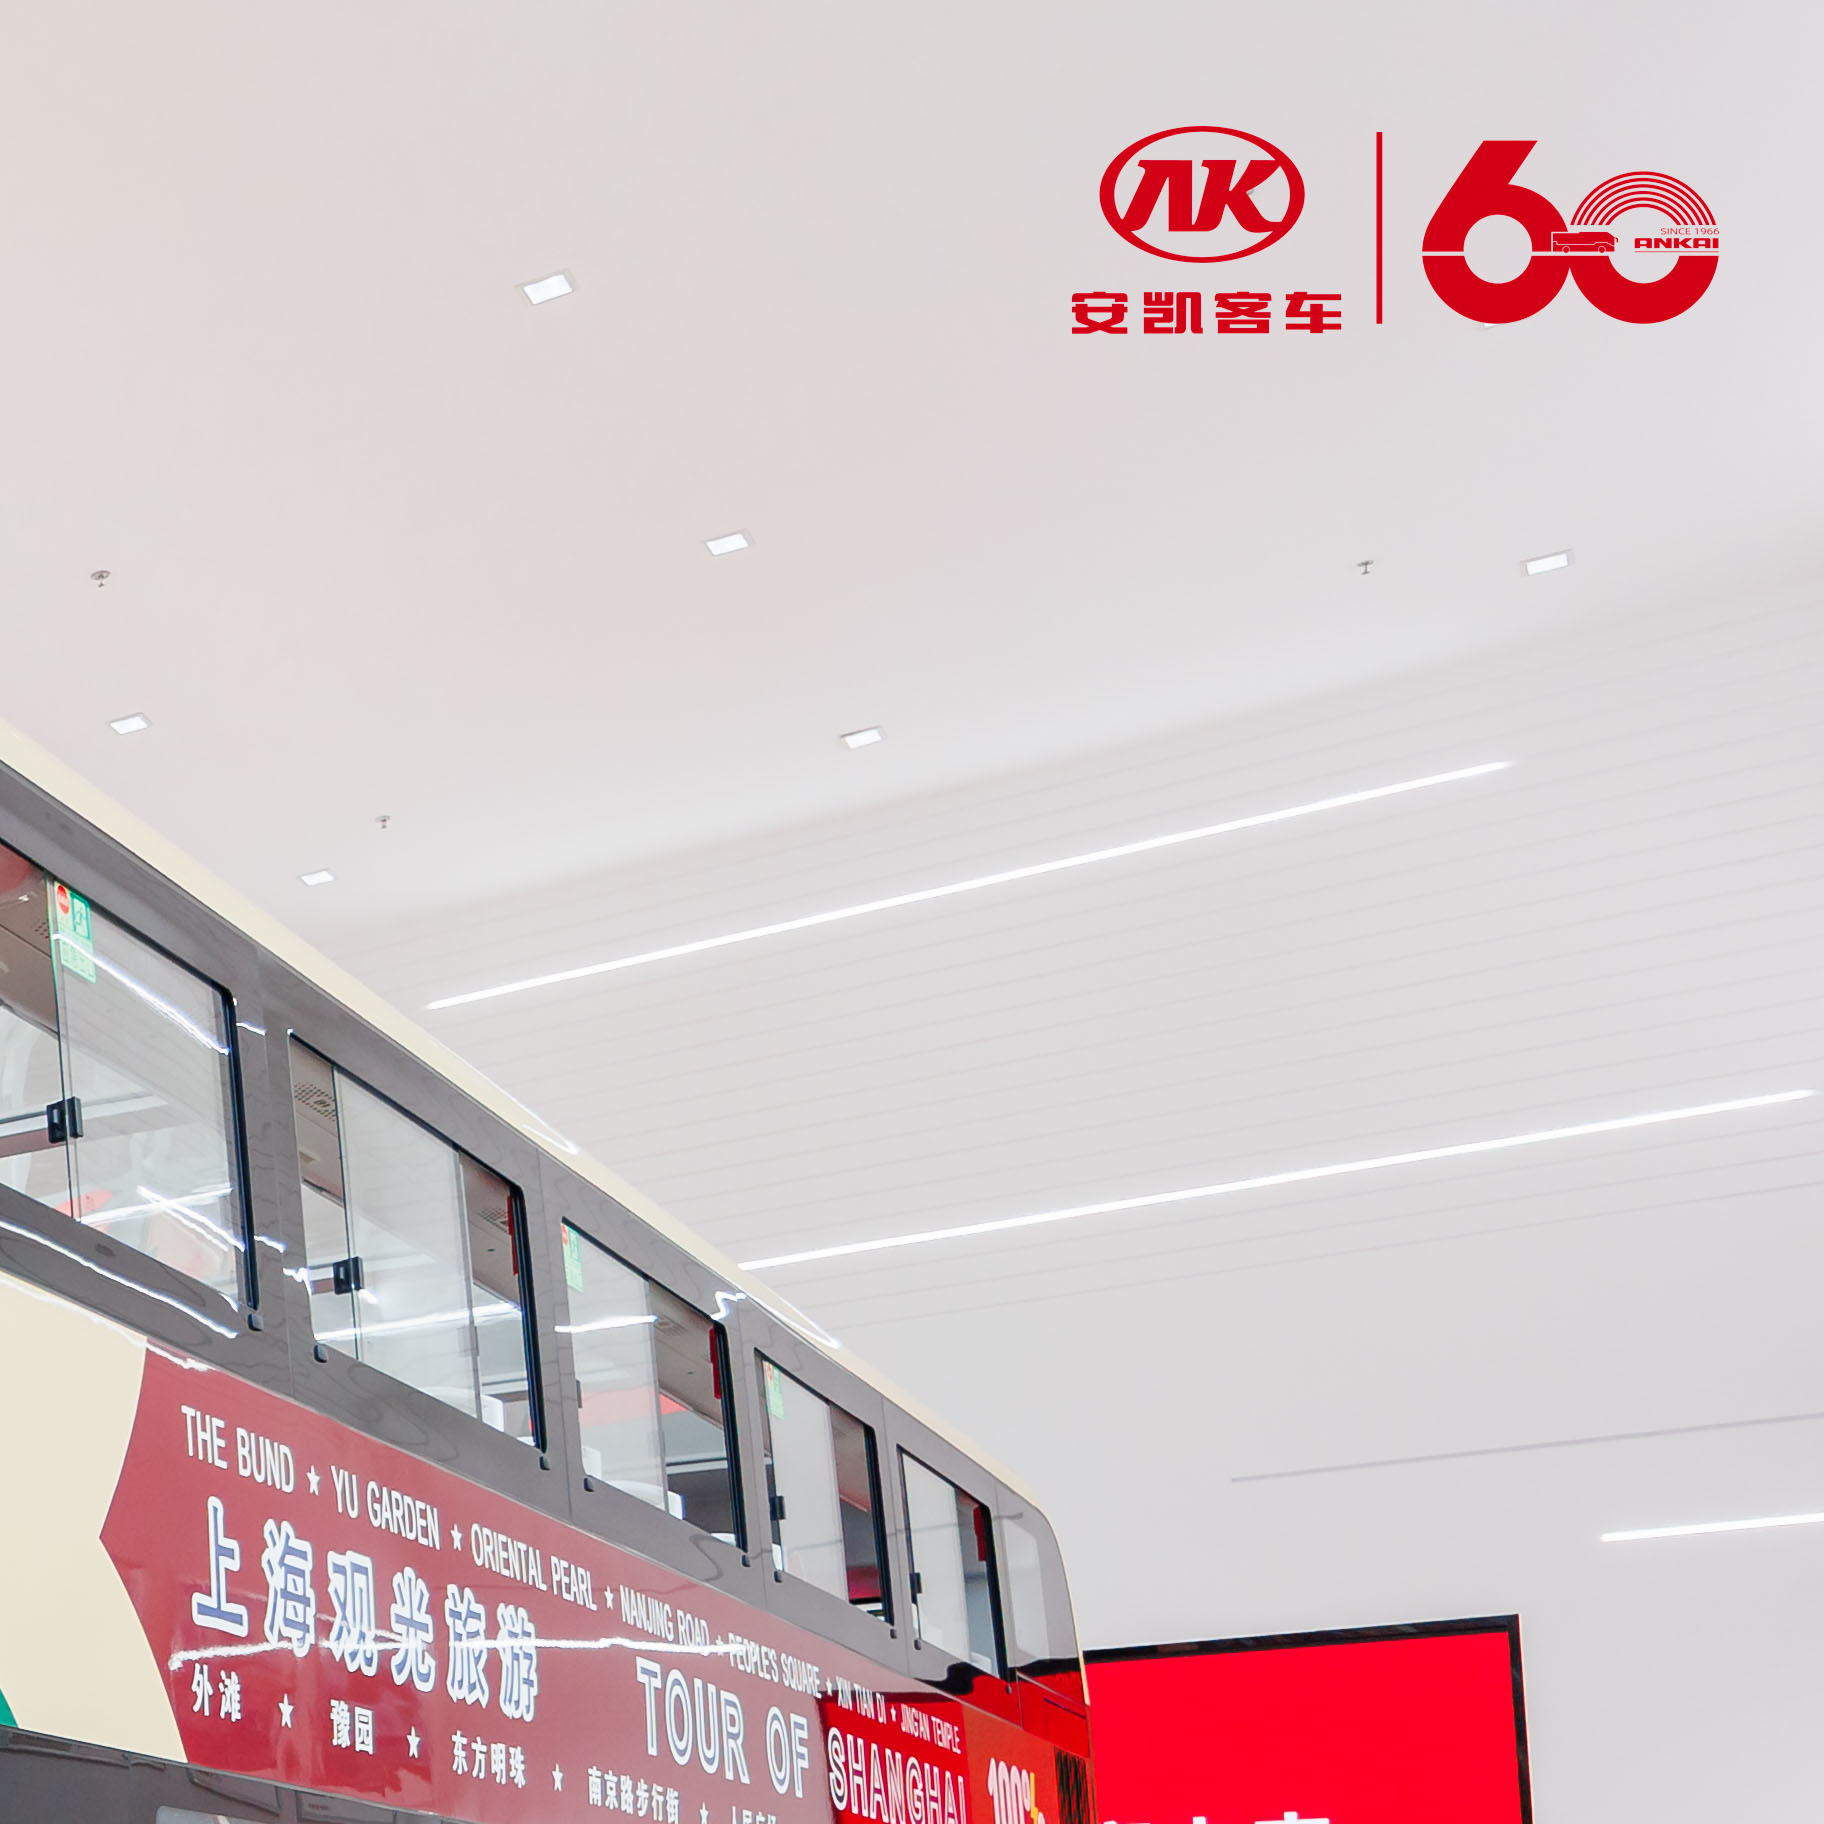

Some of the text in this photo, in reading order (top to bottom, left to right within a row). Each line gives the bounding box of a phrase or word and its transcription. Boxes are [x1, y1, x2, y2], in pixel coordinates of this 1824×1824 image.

[181, 1405, 295, 1495] THE BUND
[330, 1465, 440, 1551] YU GARDEN
[471, 1523, 598, 1611] ORIENTAL PEARL
[191, 1496, 538, 1724] 上海观光旅游
[619, 1585, 710, 1650] NANJING ROAD
[191, 1663, 242, 1724] 外滩
[780, 1654, 822, 1699] SQUARE
[836, 1676, 887, 1724] XIN TIAN DI
[330, 1698, 374, 1755] 豫园
[636, 1656, 750, 1785] TOUR
[766, 1706, 809, 1799] OF
[931, 1716, 961, 1755] TEMPLE
[452, 1730, 527, 1788] 东方明珠
